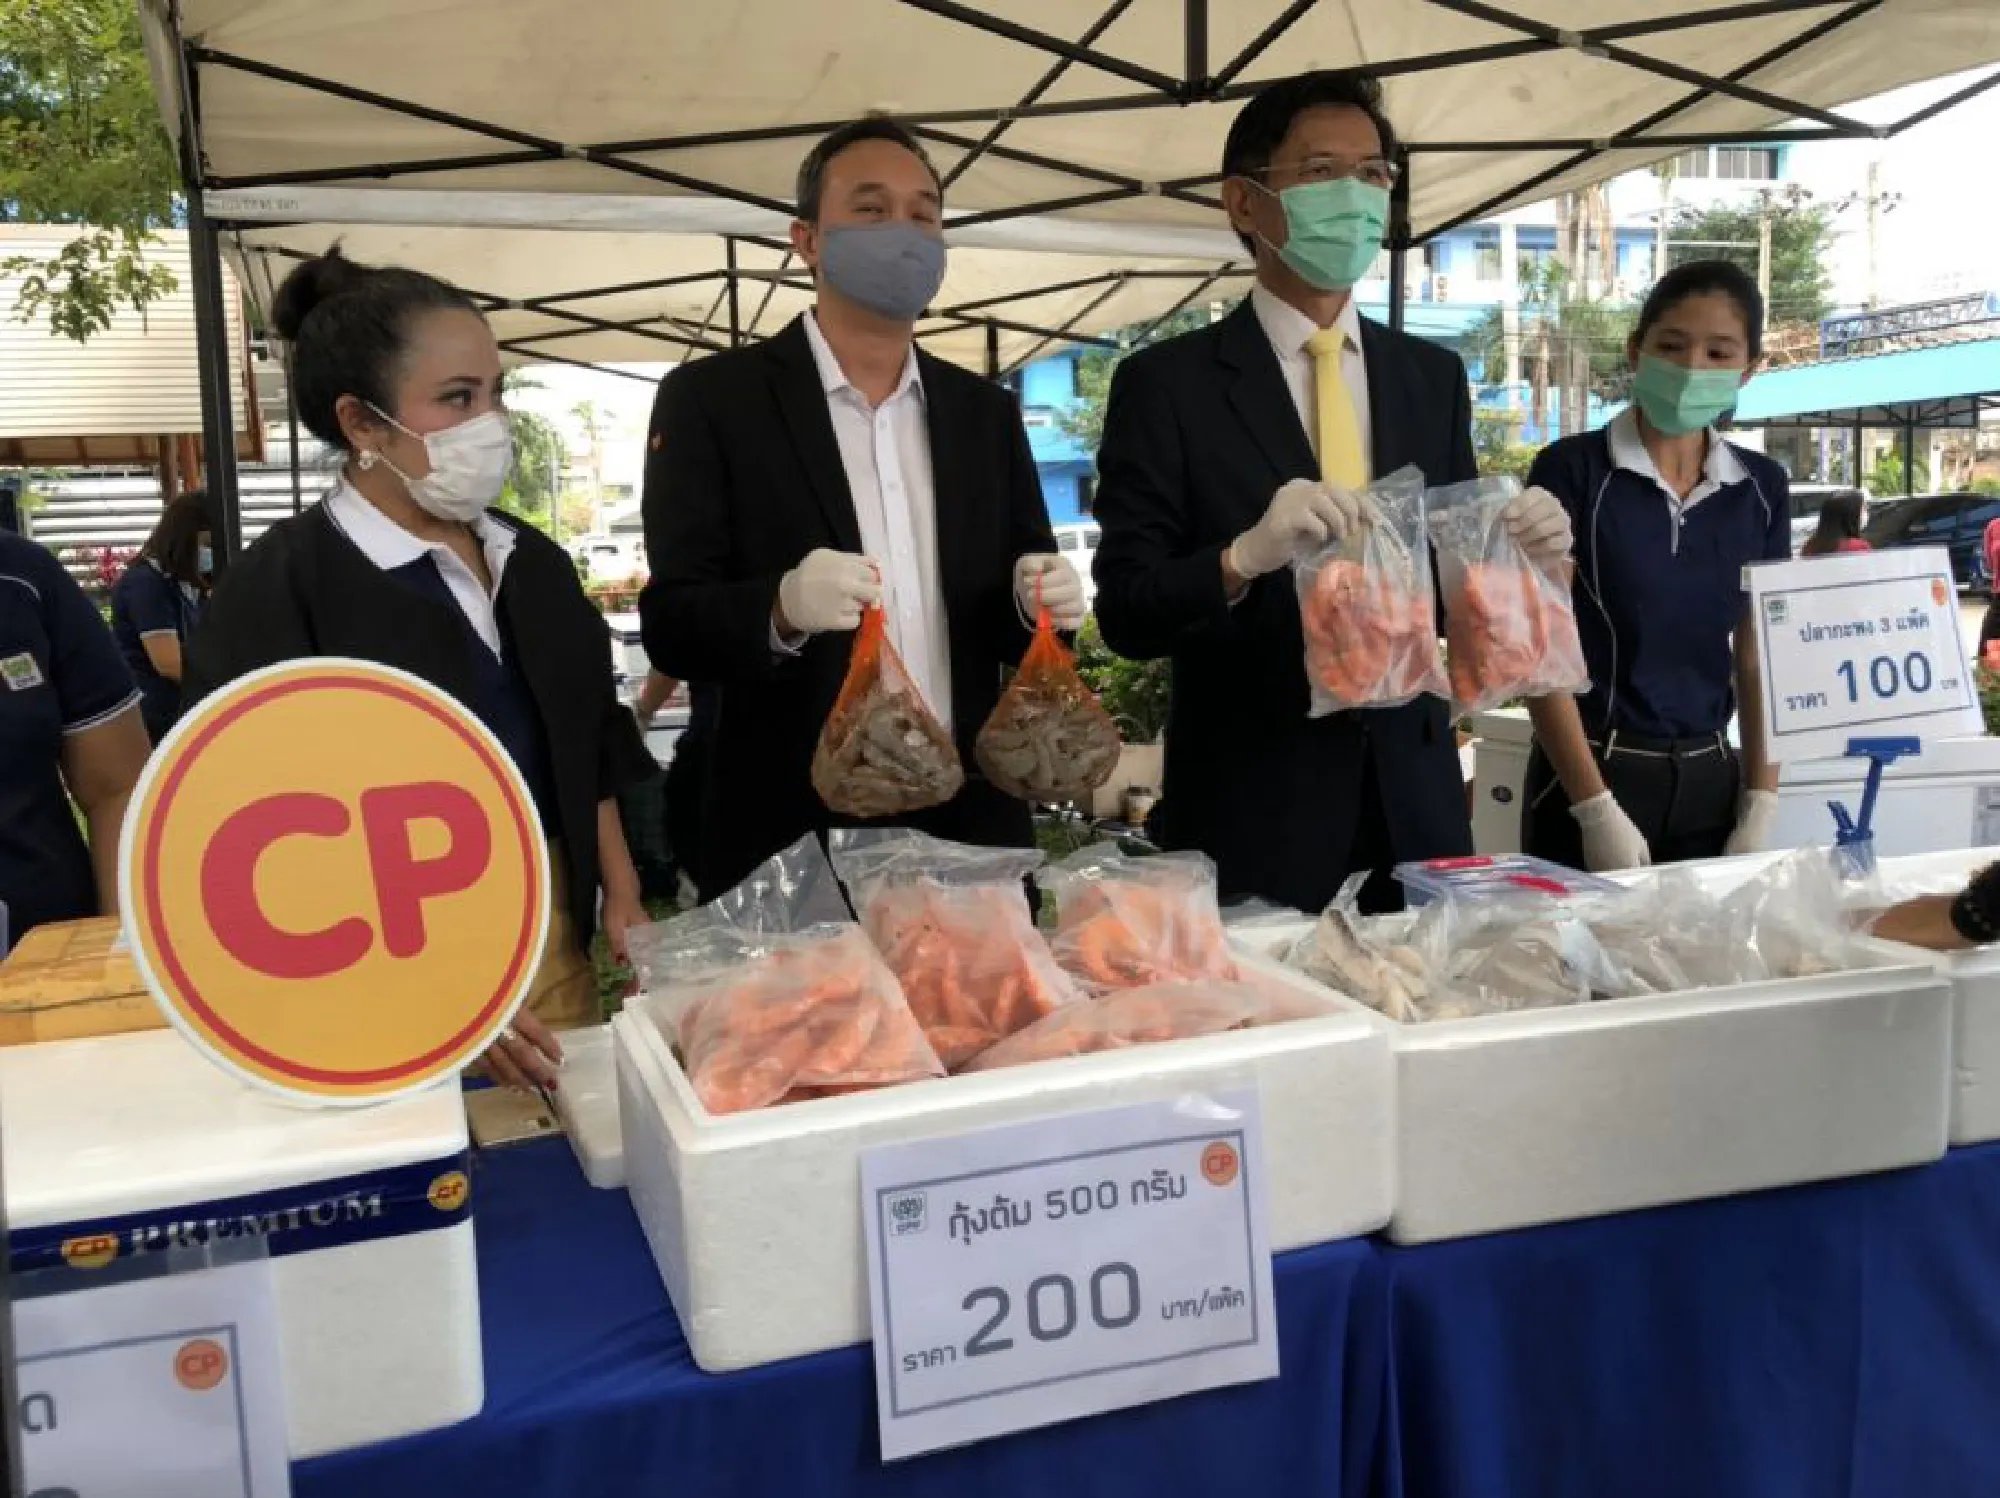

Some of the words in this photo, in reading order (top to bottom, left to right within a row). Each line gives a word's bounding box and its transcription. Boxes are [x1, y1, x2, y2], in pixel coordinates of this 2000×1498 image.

[1879, 617, 1891, 633] 3
[1785, 692, 1827, 710] ราคา
[1836, 651, 1932, 703] 100
[200, 781, 492, 978] CP
[1206, 1152, 1233, 1175] CP
[949, 1194, 1032, 1246] กุ้งต้ม
[1045, 1180, 1119, 1220] 500
[1130, 1169, 1187, 1206] กรัม
[903, 1344, 957, 1372] ราคา
[961, 1261, 1141, 1358] 200
[180, 1353, 219, 1378] CP
